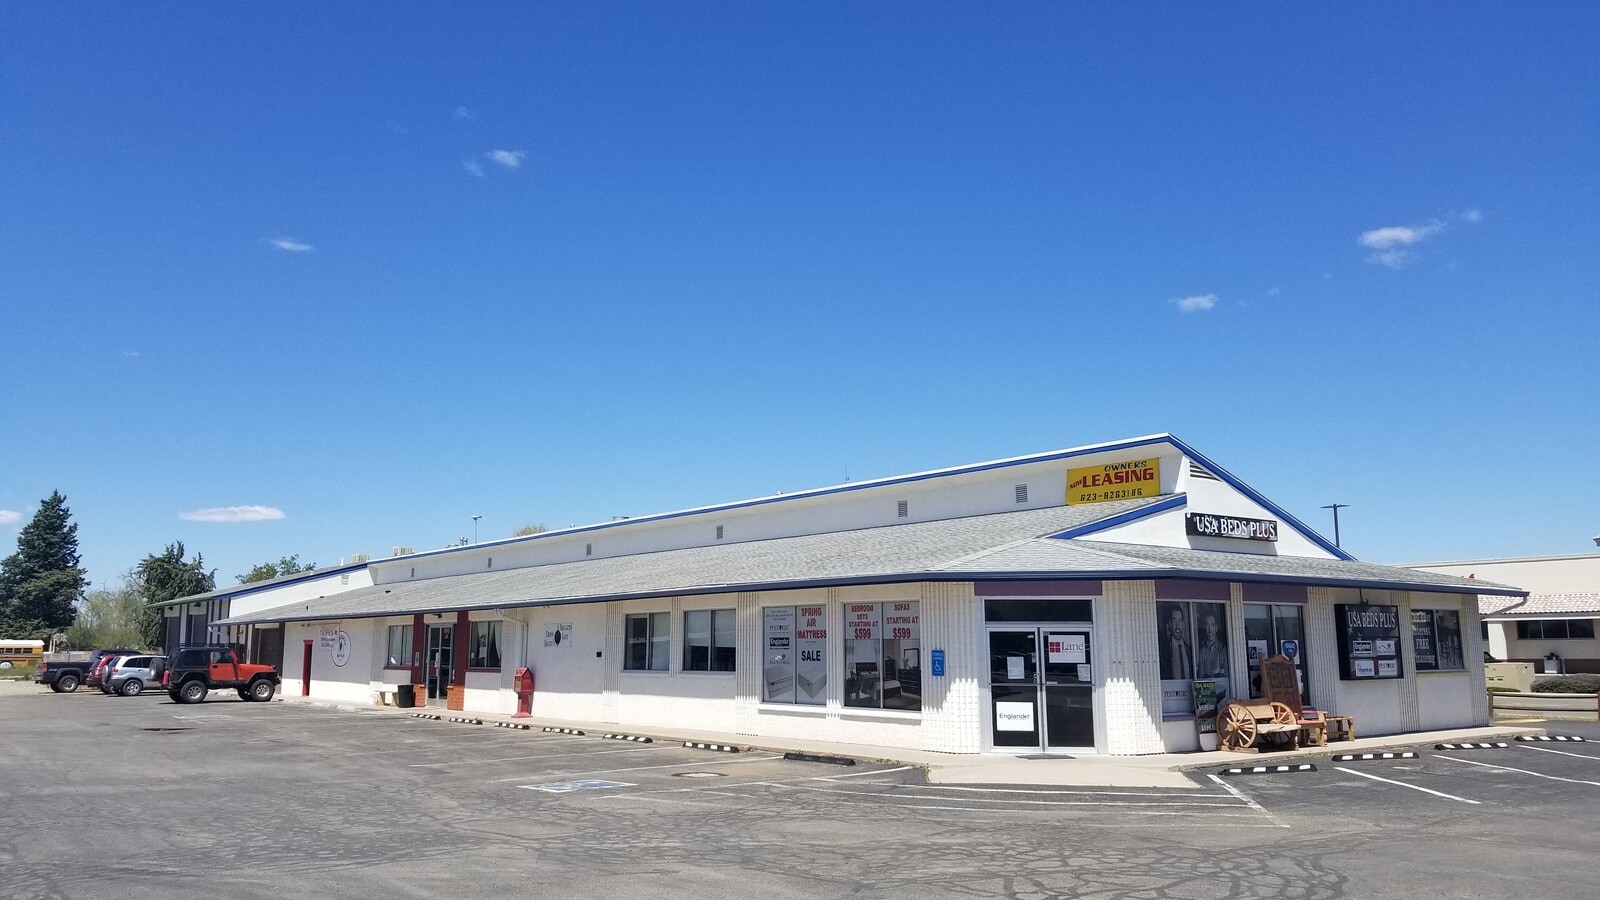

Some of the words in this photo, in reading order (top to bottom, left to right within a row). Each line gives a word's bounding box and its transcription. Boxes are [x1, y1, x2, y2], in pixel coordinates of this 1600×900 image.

[1104, 461, 1147, 472] OWNERS
[1082, 468, 1154, 488] LEASING
[1080, 488, 1142, 501] 623-8263186
[1196, 516, 1218, 534] USA
[1220, 519, 1248, 535] BEDS
[1250, 521, 1275, 538] PLUS
[801, 607, 822, 617] SPRING
[851, 604, 874, 612] BEDROOM
[894, 603, 910, 611] SOFAS
[806, 618, 816, 627] AIR
[886, 616, 911, 624] STARTING
[912, 616, 918, 624] AT
[1347, 611, 1361, 627] USA
[1362, 612, 1379, 628] BEDS
[1380, 612, 1396, 628] PLUS
[797, 629, 827, 639] MATTRESS
[854, 628, 871, 639] $599
[892, 627, 911, 639] $599
[1061, 641, 1084, 651] Lane
[801, 650, 821, 661] SALE
[999, 712, 1030, 721] Englander
